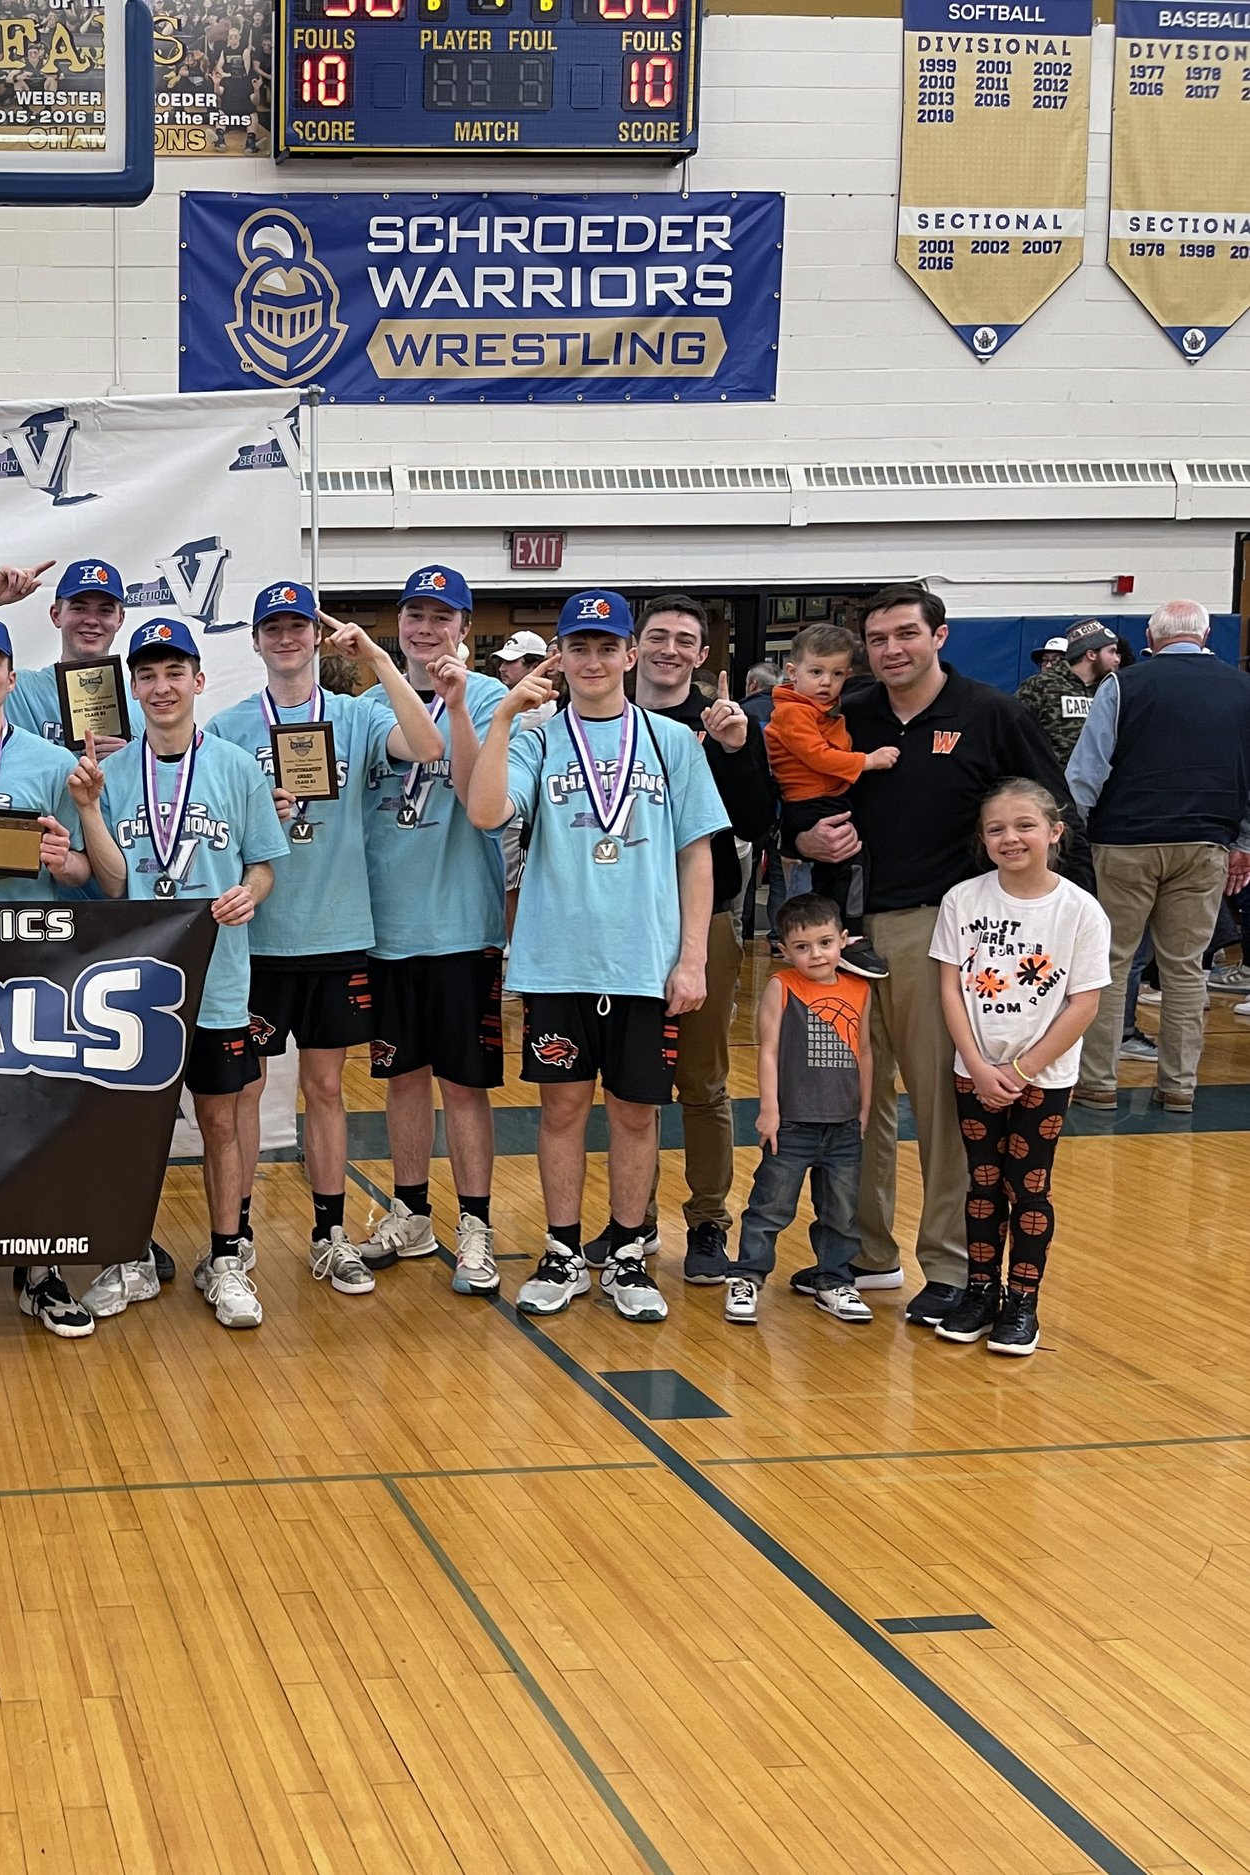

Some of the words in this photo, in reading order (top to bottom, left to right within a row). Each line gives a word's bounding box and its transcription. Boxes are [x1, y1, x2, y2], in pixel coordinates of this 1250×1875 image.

[948, 3, 1046, 23] SOFTBALL
[1158, 10, 1250, 29] BASEBALL
[293, 28, 355, 50] FOULS
[420, 29, 491, 51] PLAYER
[508, 30, 558, 51] FOUL
[621, 31, 682, 53] FOULS
[917, 35, 1072, 57] DIVISIONAL
[919, 58, 956, 73] 1999
[976, 60, 1012, 75] 2001
[1033, 62, 1072, 77] 2002
[1130, 65, 1165, 80] 1977
[1185, 66, 1221, 81] 1978
[302, 54, 346, 107] 10
[629, 56, 674, 109] 10
[918, 75, 955, 90] 2010
[976, 77, 1009, 91] 2011
[1032, 78, 1068, 93] 2012
[1129, 81, 1164, 96] 2016
[1185, 84, 1219, 99] 2017
[15, 90, 102, 106] WEBSTER
[918, 92, 955, 107] 2013
[974, 93, 1010, 108] 2016
[1032, 95, 1067, 110] 2017
[175, 112, 203, 126] the
[209, 112, 251, 126] Fans
[917, 109, 955, 124] 2018
[292, 120, 355, 142] SCORE
[454, 121, 519, 143] MATCH
[619, 121, 680, 143] SCORE
[917, 213, 1063, 231] SECTIONAL
[367, 215, 734, 255] SCHROEDER
[918, 240, 955, 255] 2001
[971, 240, 1010, 255] 2002
[1022, 240, 1062, 255] 2007
[1129, 242, 1165, 257] 1978
[1179, 243, 1215, 258] 1998
[1230, 245, 1250, 260] 20
[918, 256, 954, 271] 2016
[367, 264, 733, 309] WARRIORS
[384, 331, 707, 369] WRESTLING
[2, 418, 80, 490] V
[239, 451, 282, 467] SECTION
[515, 536, 560, 565] EXIT
[127, 587, 171, 603] SECTION
[154, 549, 229, 617] V
[931, 730, 961, 755] W
[403, 810, 414, 822] V
[296, 823, 310, 837] V
[600, 843, 614, 857] V
[159, 881, 172, 894] V
[980, 916, 1021, 935] JUST
[989, 943, 1015, 957] FOR
[1017, 942, 1043, 955] THE
[982, 1002, 1022, 1014] POM
